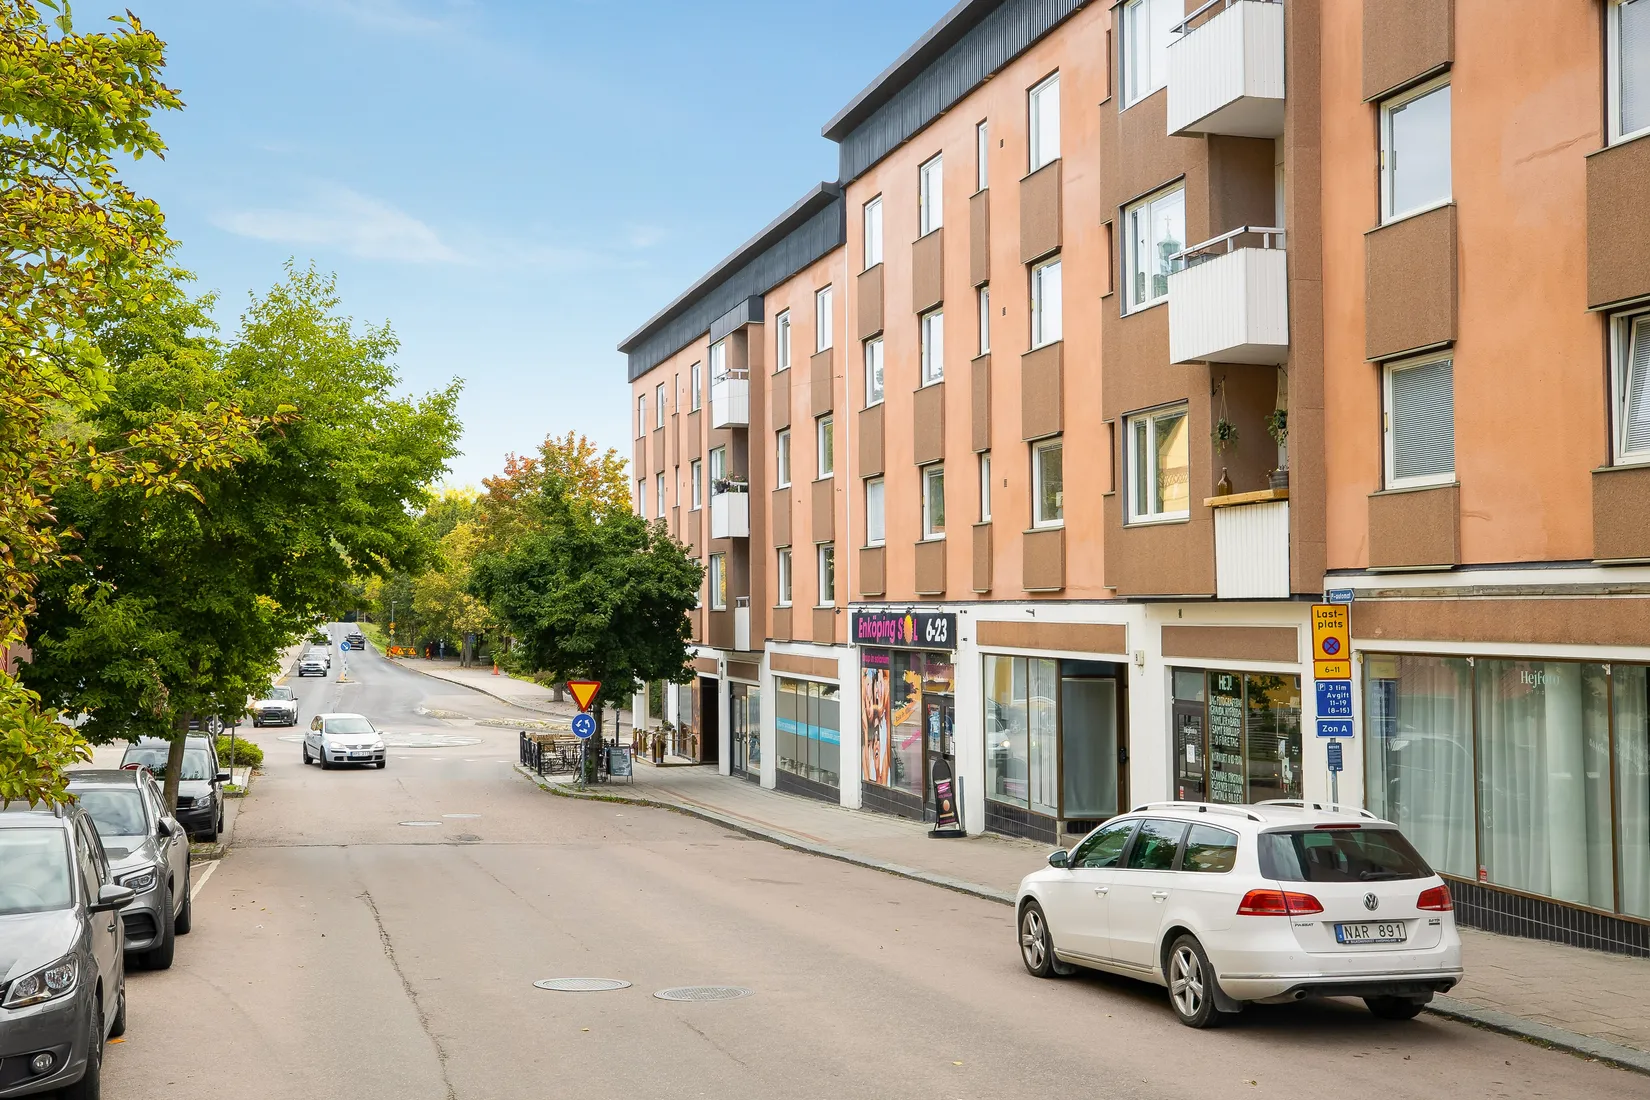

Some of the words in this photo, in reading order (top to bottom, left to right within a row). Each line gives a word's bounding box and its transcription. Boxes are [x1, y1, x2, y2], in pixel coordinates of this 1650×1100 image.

[1316, 610, 1343, 618] Last-
[858, 615, 896, 644] Enköping
[925, 618, 948, 642] 6-23
[1317, 620, 1343, 630] plats
[1218, 674, 1233, 691] HEJ!
[1326, 692, 1349, 700] Avgift
[1344, 925, 1370, 939] NAR
[1378, 924, 1402, 938] 891
